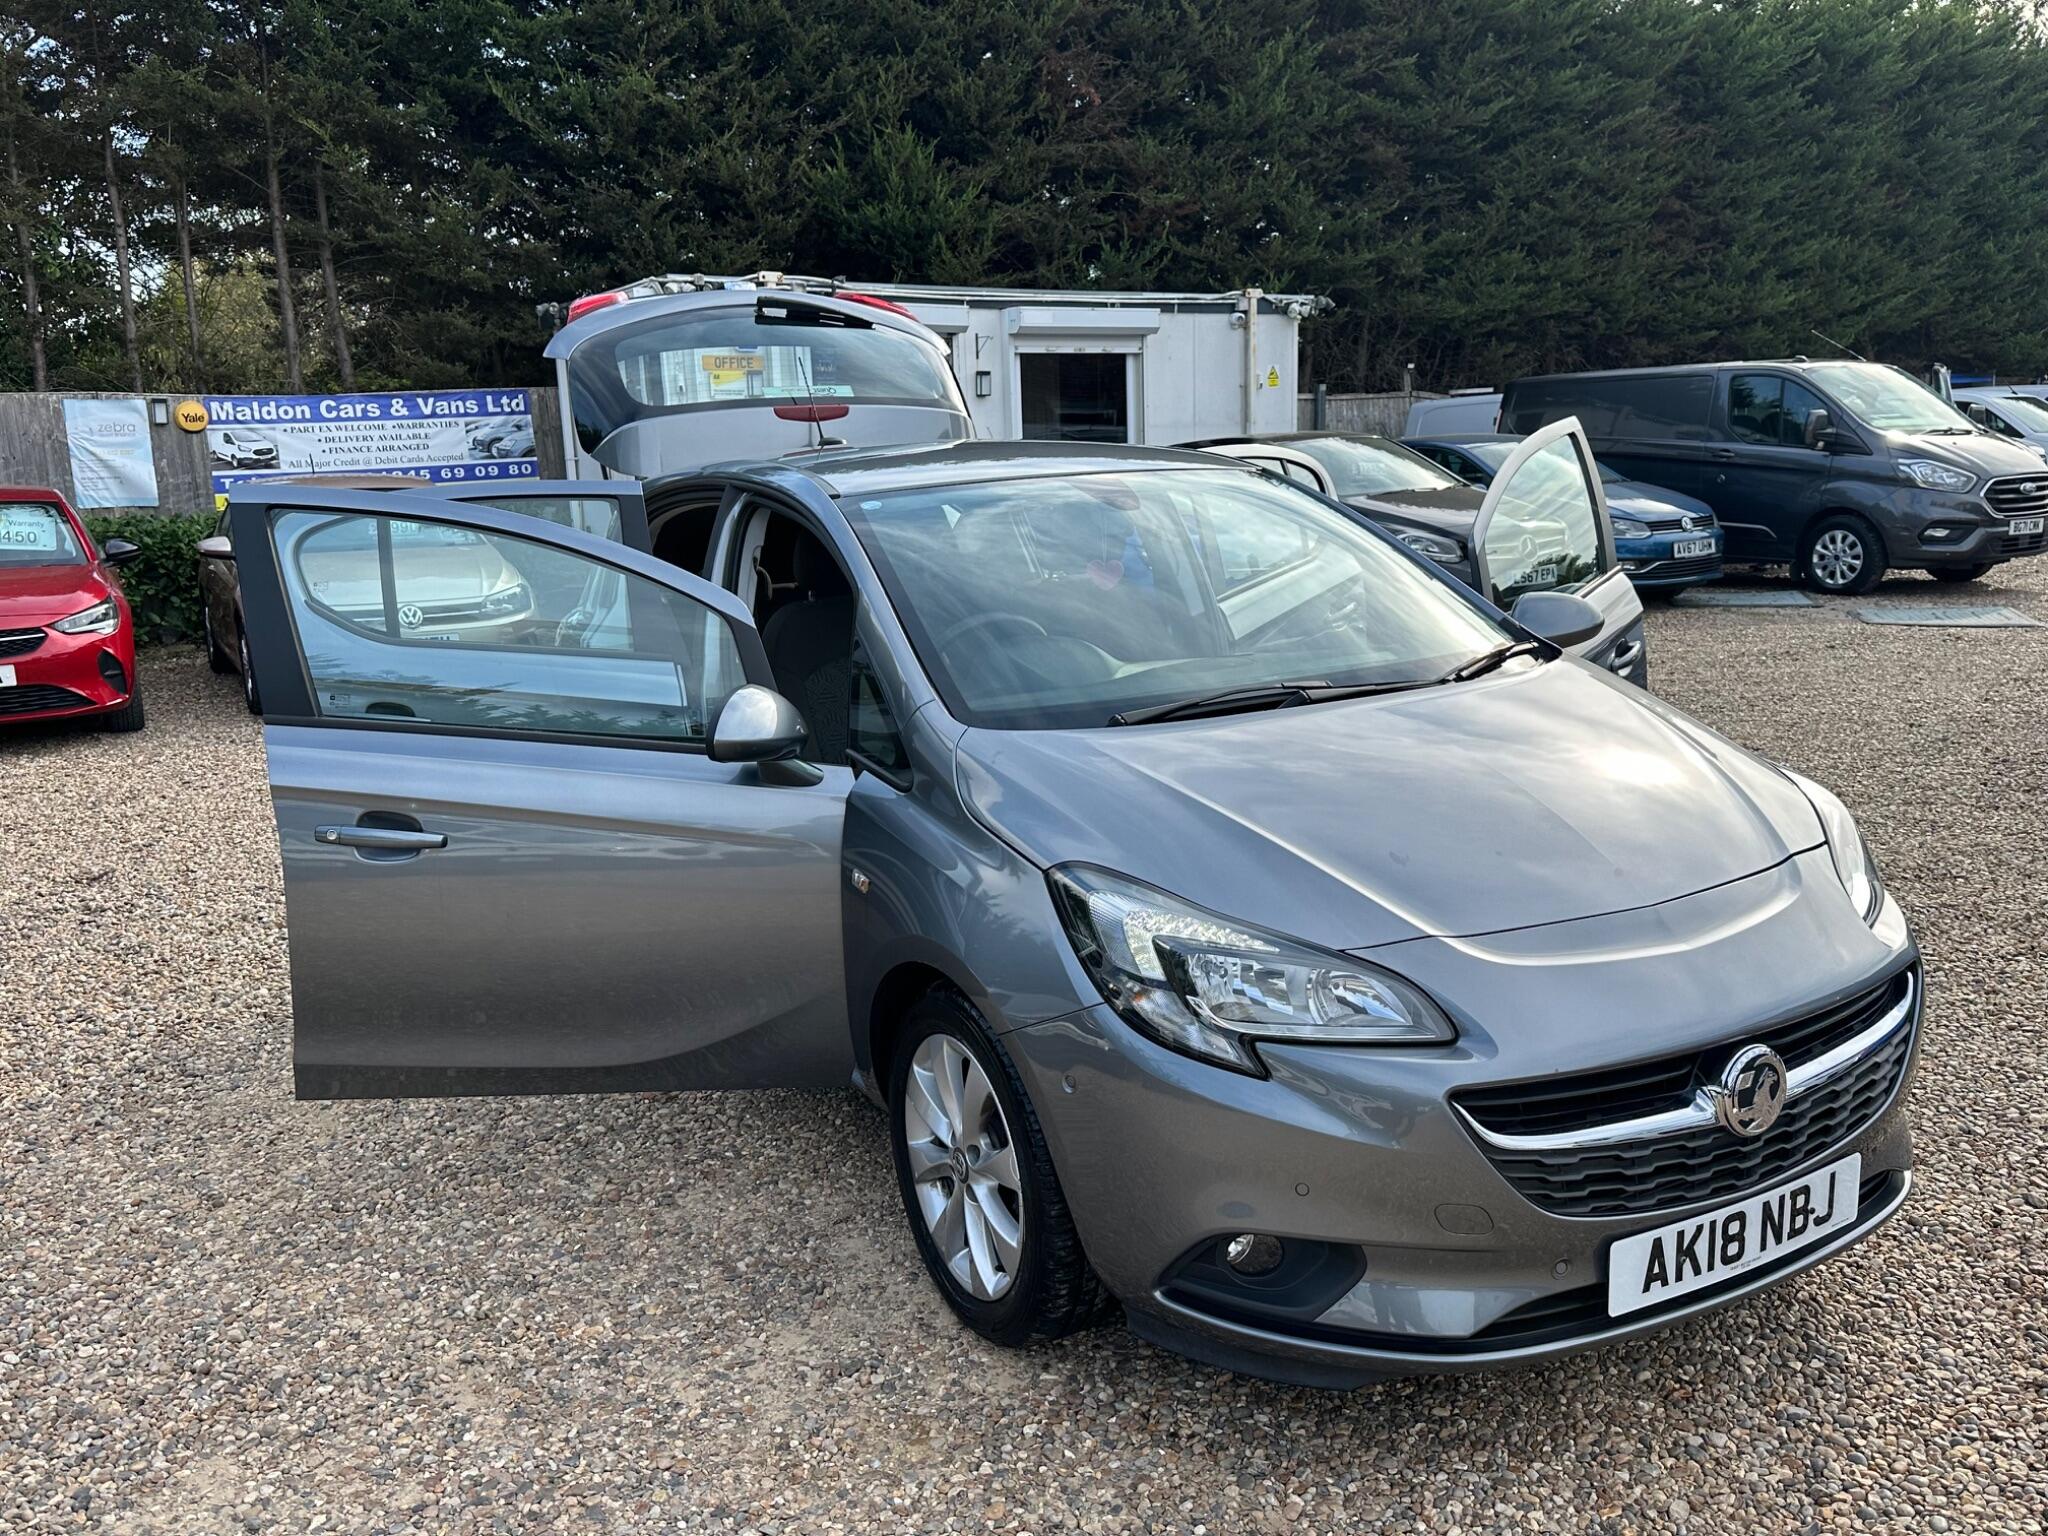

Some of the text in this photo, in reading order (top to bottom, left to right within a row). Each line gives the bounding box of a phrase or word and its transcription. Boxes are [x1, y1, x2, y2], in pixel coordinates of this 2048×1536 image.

[714, 356, 754, 369] OFFICE
[209, 394, 525, 421] Maldon Cars & Vans Ltd
[181, 412, 205, 423] Yale
[97, 421, 136, 433] zebra
[290, 426, 315, 434] PART
[319, 425, 332, 433] EX
[334, 423, 387, 432] WELCOME
[324, 432, 432, 444] DELIVERY AVAILABLE
[328, 442, 430, 455] FINANCE ARRANGED
[288, 459, 303, 469] All
[304, 459, 331, 470] Major
[333, 458, 360, 467] Credit
[375, 455, 399, 465] Debit
[400, 454, 425, 464] Cards
[426, 452, 465, 463] Accepted
[440, 467, 466, 479] 69
[475, 465, 499, 477] 09
[508, 463, 533, 475] 80
[8, 519, 45, 529] Warranty
[1677, 541, 1698, 555] AV67
[1642, 1171, 1837, 1294] AK18 NBJ
